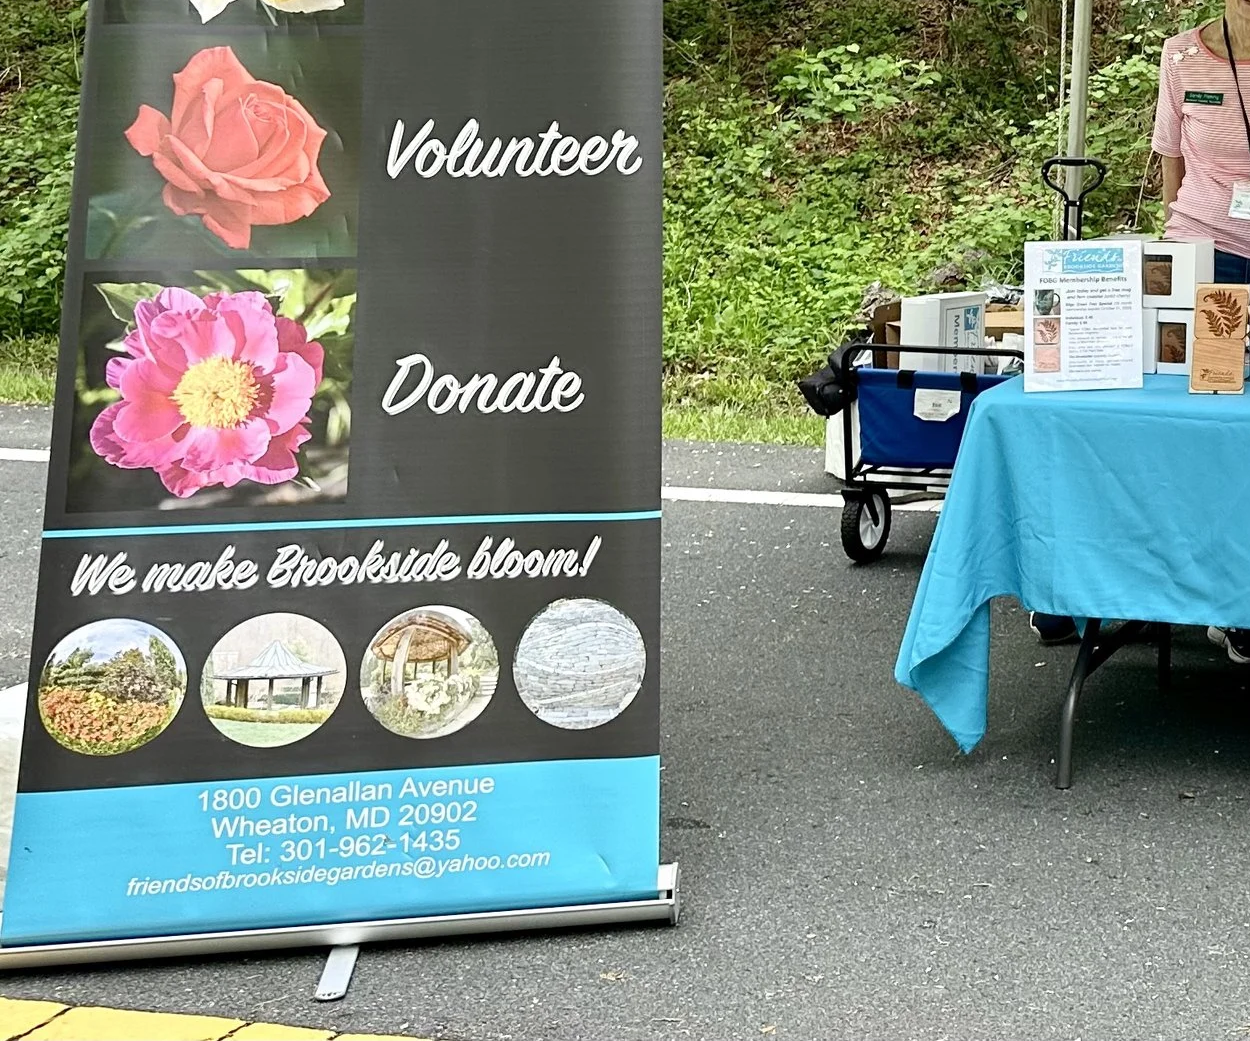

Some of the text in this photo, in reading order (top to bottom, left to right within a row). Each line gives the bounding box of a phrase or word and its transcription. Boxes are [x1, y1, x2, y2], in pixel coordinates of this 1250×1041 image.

[386, 119, 643, 179] Volunteer
[382, 353, 584, 415] Donate
[71, 535, 602, 597] We make Brookside bloom!
[198, 775, 495, 813] 1800 Glenallan Avenue
[211, 800, 477, 842] Wheaton, MD 20902
[226, 828, 460, 867] Tel: 301-962-1435
[126, 849, 550, 897] friendsofbrooksidegardens@yahoo.com
